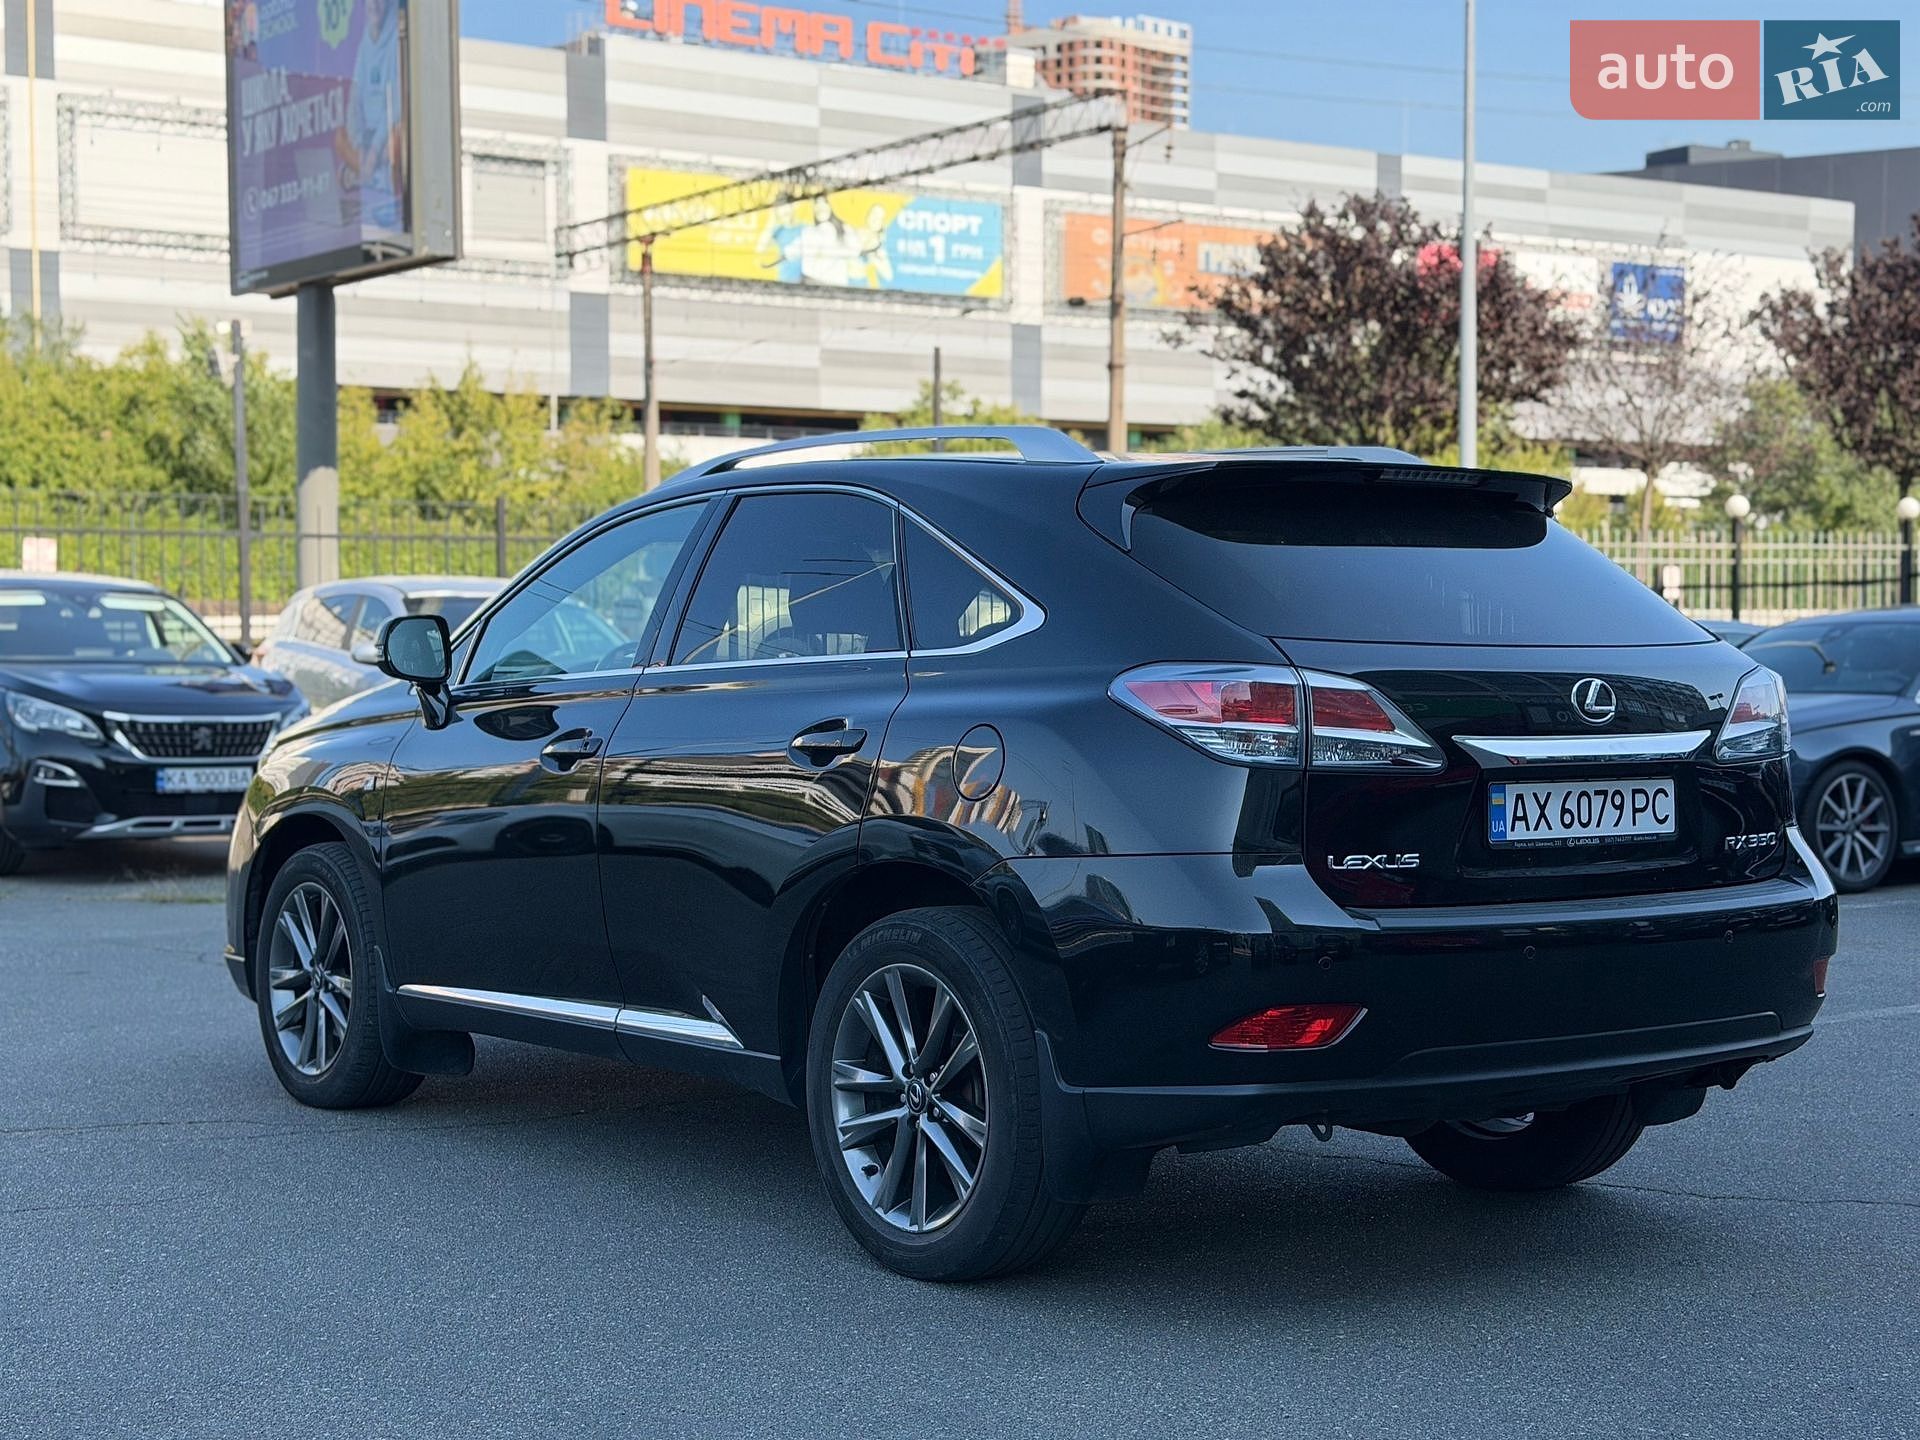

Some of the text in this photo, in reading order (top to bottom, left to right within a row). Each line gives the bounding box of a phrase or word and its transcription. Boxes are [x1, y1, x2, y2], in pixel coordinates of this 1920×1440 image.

[897, 209, 983, 236] СПОРТ
[928, 234, 945, 264] 1
[1510, 786, 1669, 833] AX 6079 PC
[1491, 820, 1506, 834] UA
[1327, 853, 1420, 870] LEXUS
[860, 928, 922, 951] MICHELIN
